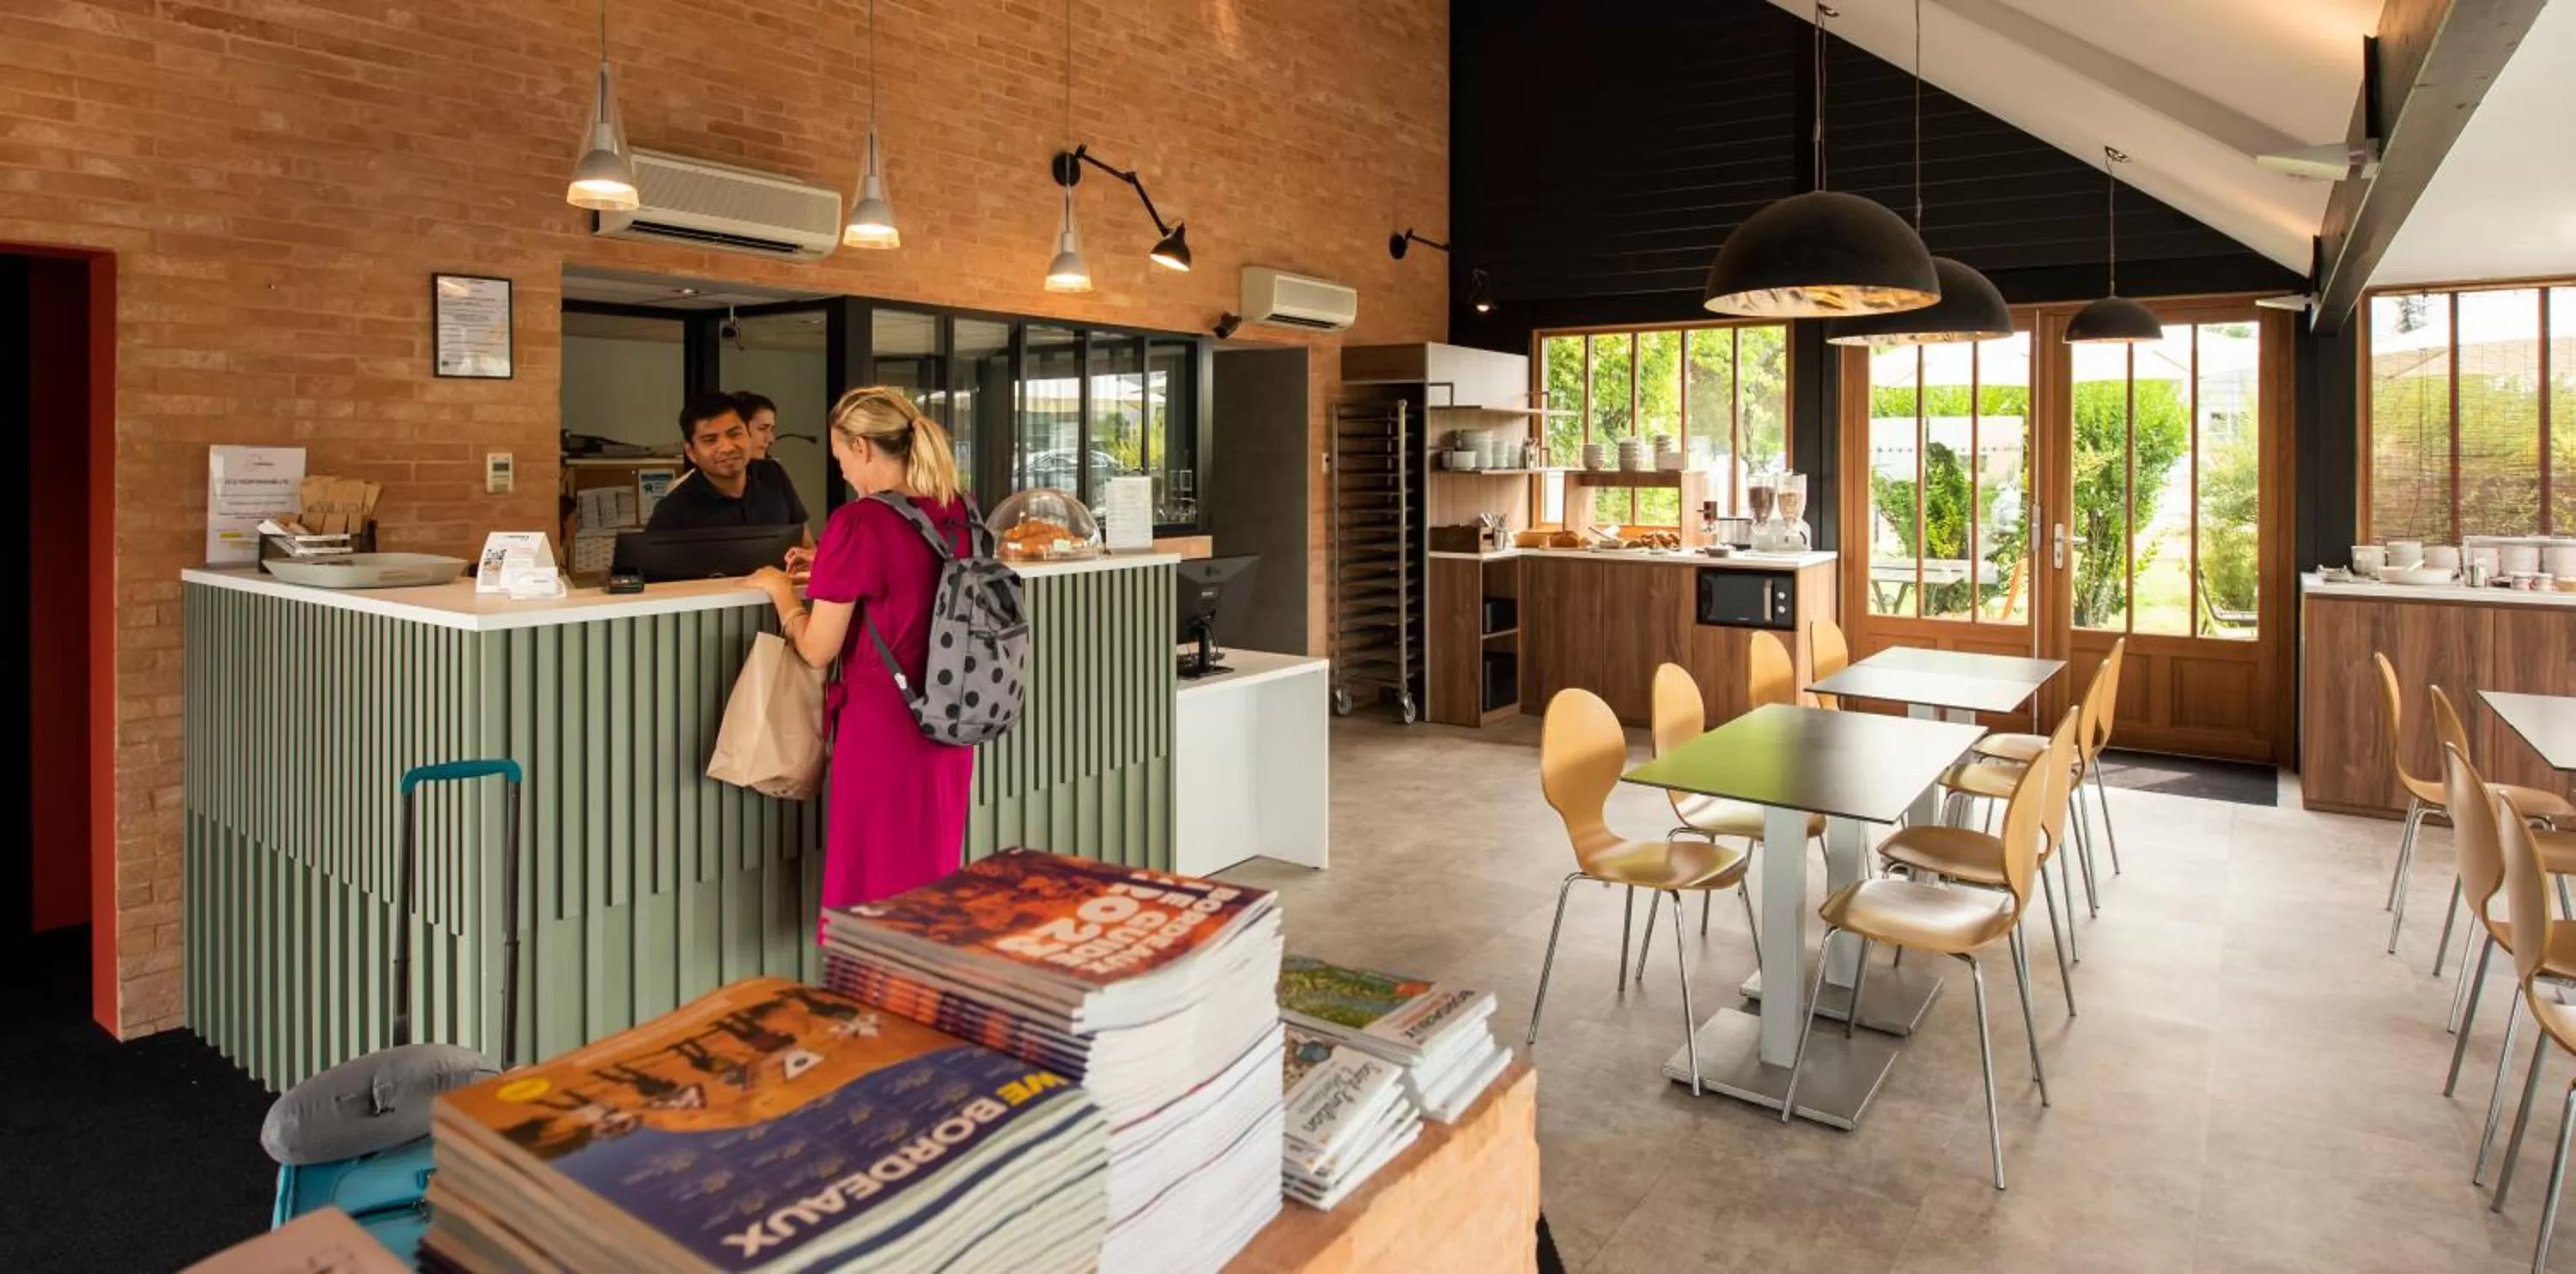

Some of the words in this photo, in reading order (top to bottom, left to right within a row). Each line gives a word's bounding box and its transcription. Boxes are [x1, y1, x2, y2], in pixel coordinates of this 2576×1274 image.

[994, 871, 1175, 957] 2023
[1044, 910, 1169, 968] GUIDE
[1078, 887, 1242, 974] BORDEAUX
[996, 1071, 1069, 1106] WE
[722, 1096, 1009, 1259] BORDEAUX
